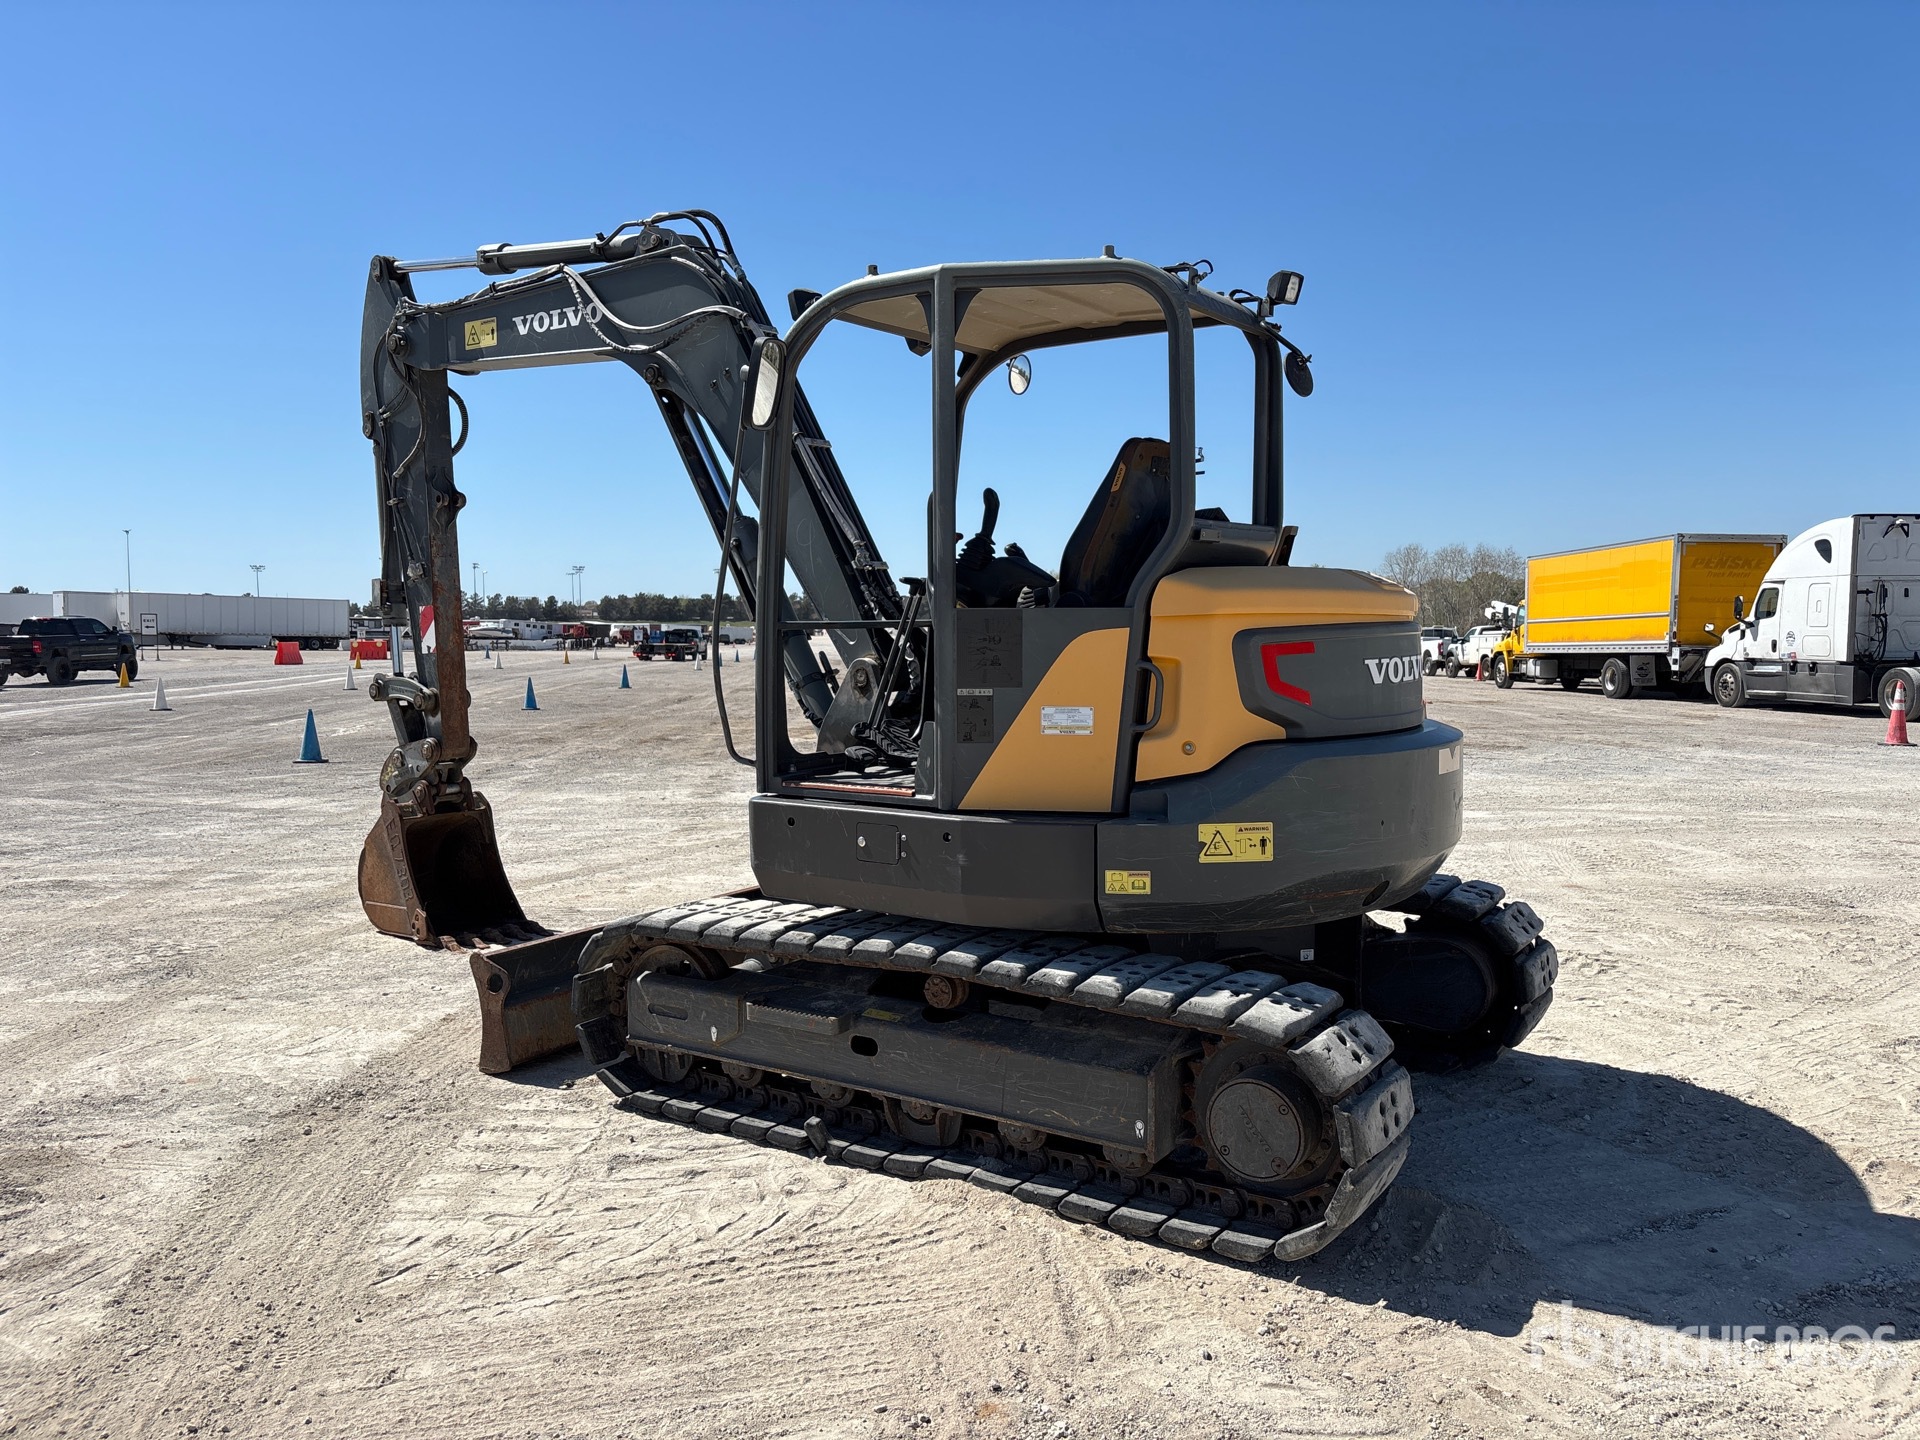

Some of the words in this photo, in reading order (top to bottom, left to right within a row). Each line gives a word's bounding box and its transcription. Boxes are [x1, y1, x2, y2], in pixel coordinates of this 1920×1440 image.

[512, 302, 603, 336] VOLVO
[1690, 556, 1767, 569] PENSKE
[1365, 655, 1423, 684] VOLV
